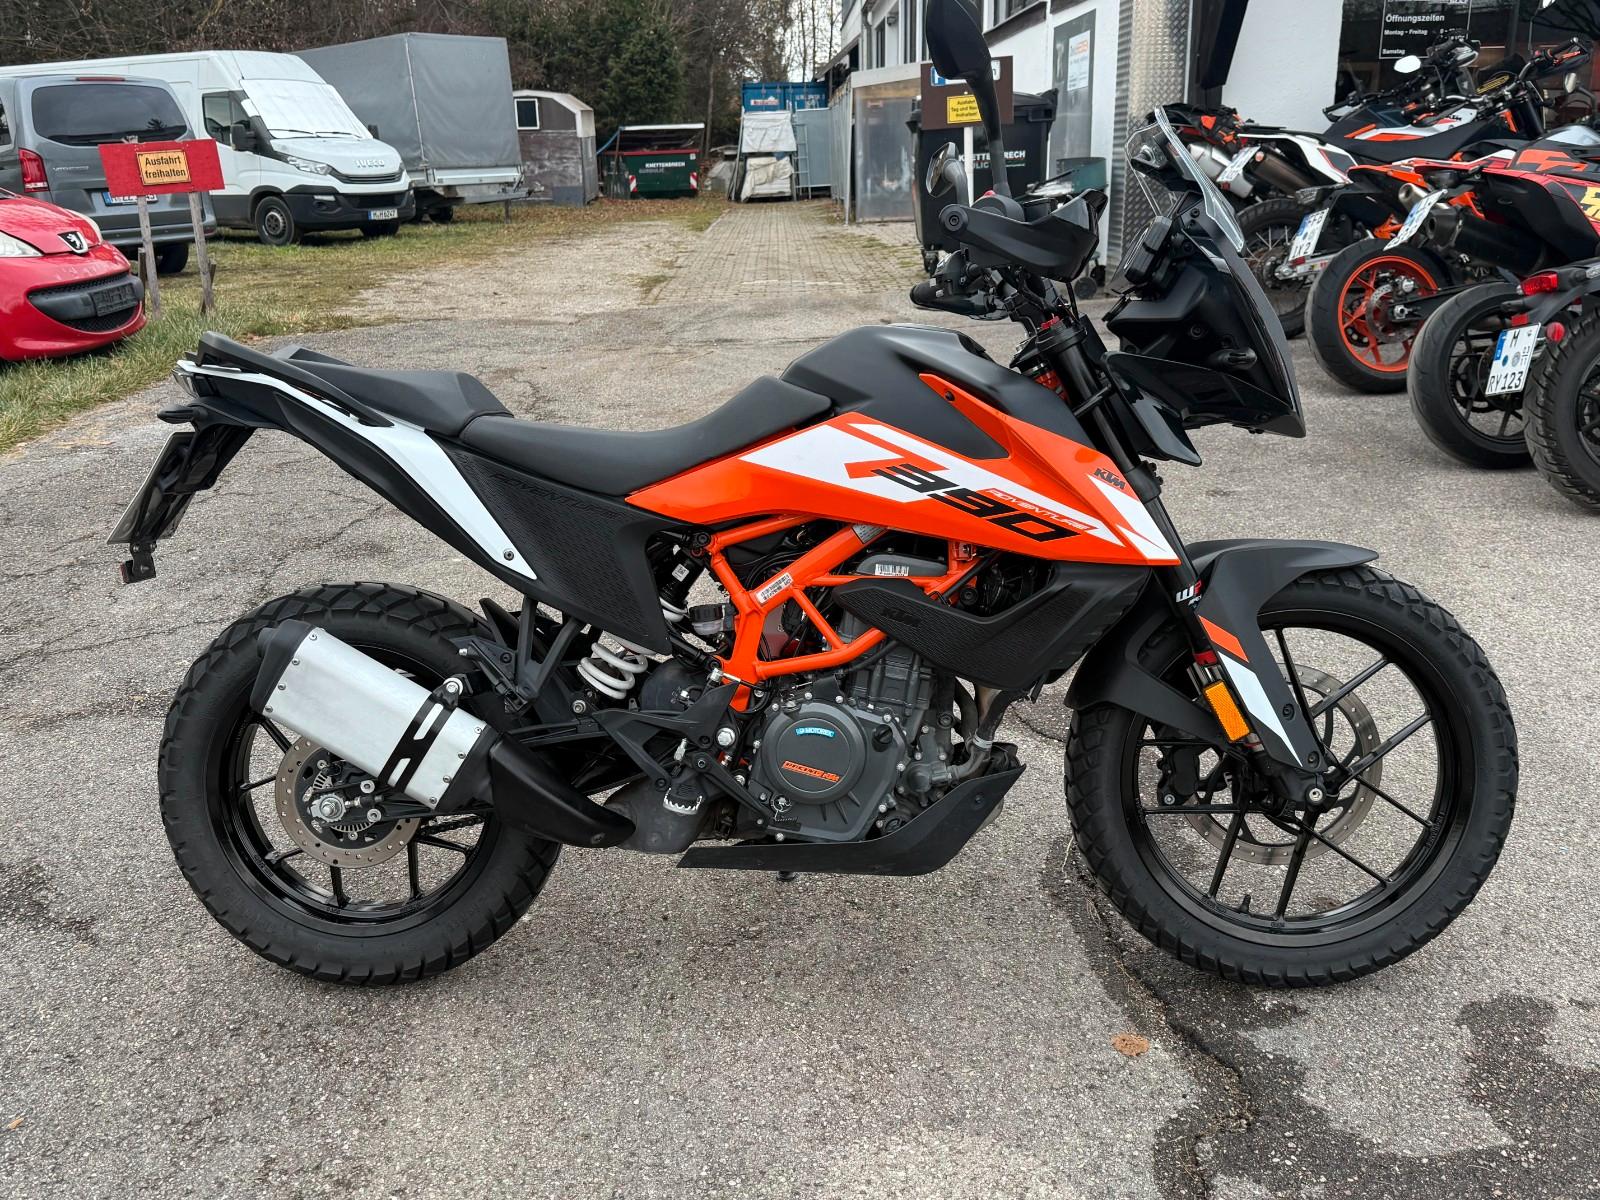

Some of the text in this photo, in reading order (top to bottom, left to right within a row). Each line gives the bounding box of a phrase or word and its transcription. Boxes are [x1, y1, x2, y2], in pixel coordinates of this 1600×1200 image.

[1385, 13, 1445, 23] Öffnungszeiten
[145, 155, 182, 166] Ausfahrt
[355, 159, 385, 168] IVECO
[144, 168, 187, 179] freihalten
[1093, 467, 1126, 490] KTM
[871, 463, 1082, 543] 390
[987, 488, 1090, 532] ADVENTURE
